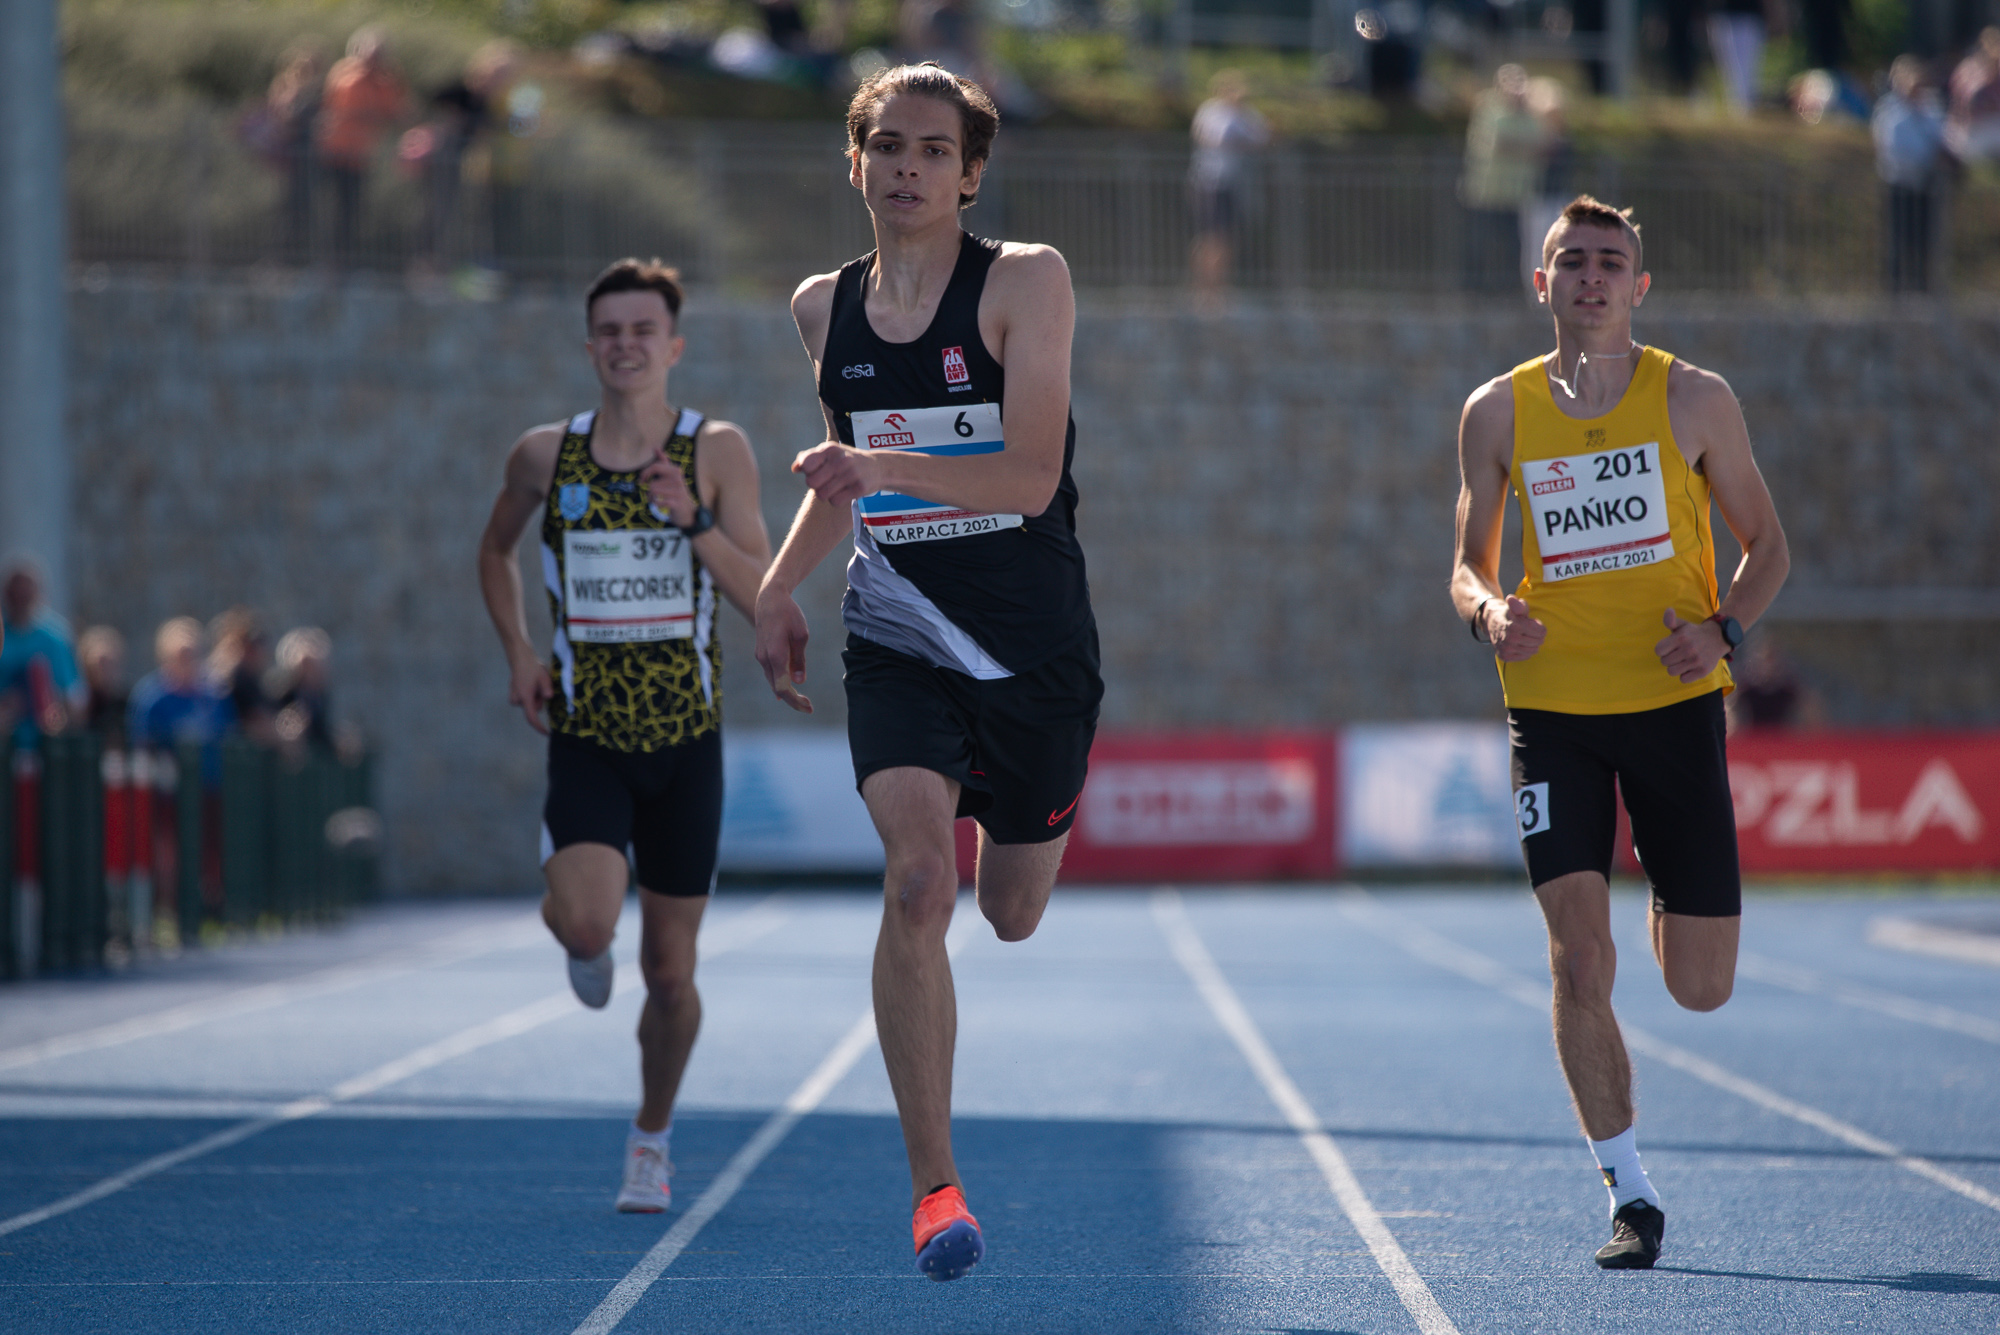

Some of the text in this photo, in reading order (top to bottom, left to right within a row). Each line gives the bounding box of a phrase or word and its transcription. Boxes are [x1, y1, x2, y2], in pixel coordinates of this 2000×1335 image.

[841, 363, 876, 379] esa
[945, 363, 965, 374] AZS
[947, 371, 967, 381] AWF
[954, 411, 974, 438] 6
[870, 433, 912, 447] ORLEN
[1593, 448, 1652, 483] 201
[1533, 477, 1573, 494] ORLEN
[885, 517, 999, 543] KARPACZ 2021
[1544, 496, 1648, 538] PAŃKO
[632, 536, 682, 561] 397
[1554, 556, 1621, 579] KARPACZ
[1624, 549, 1656, 567] 2021
[572, 576, 686, 602] WIECZOREK
[1520, 789, 1539, 832] 3
